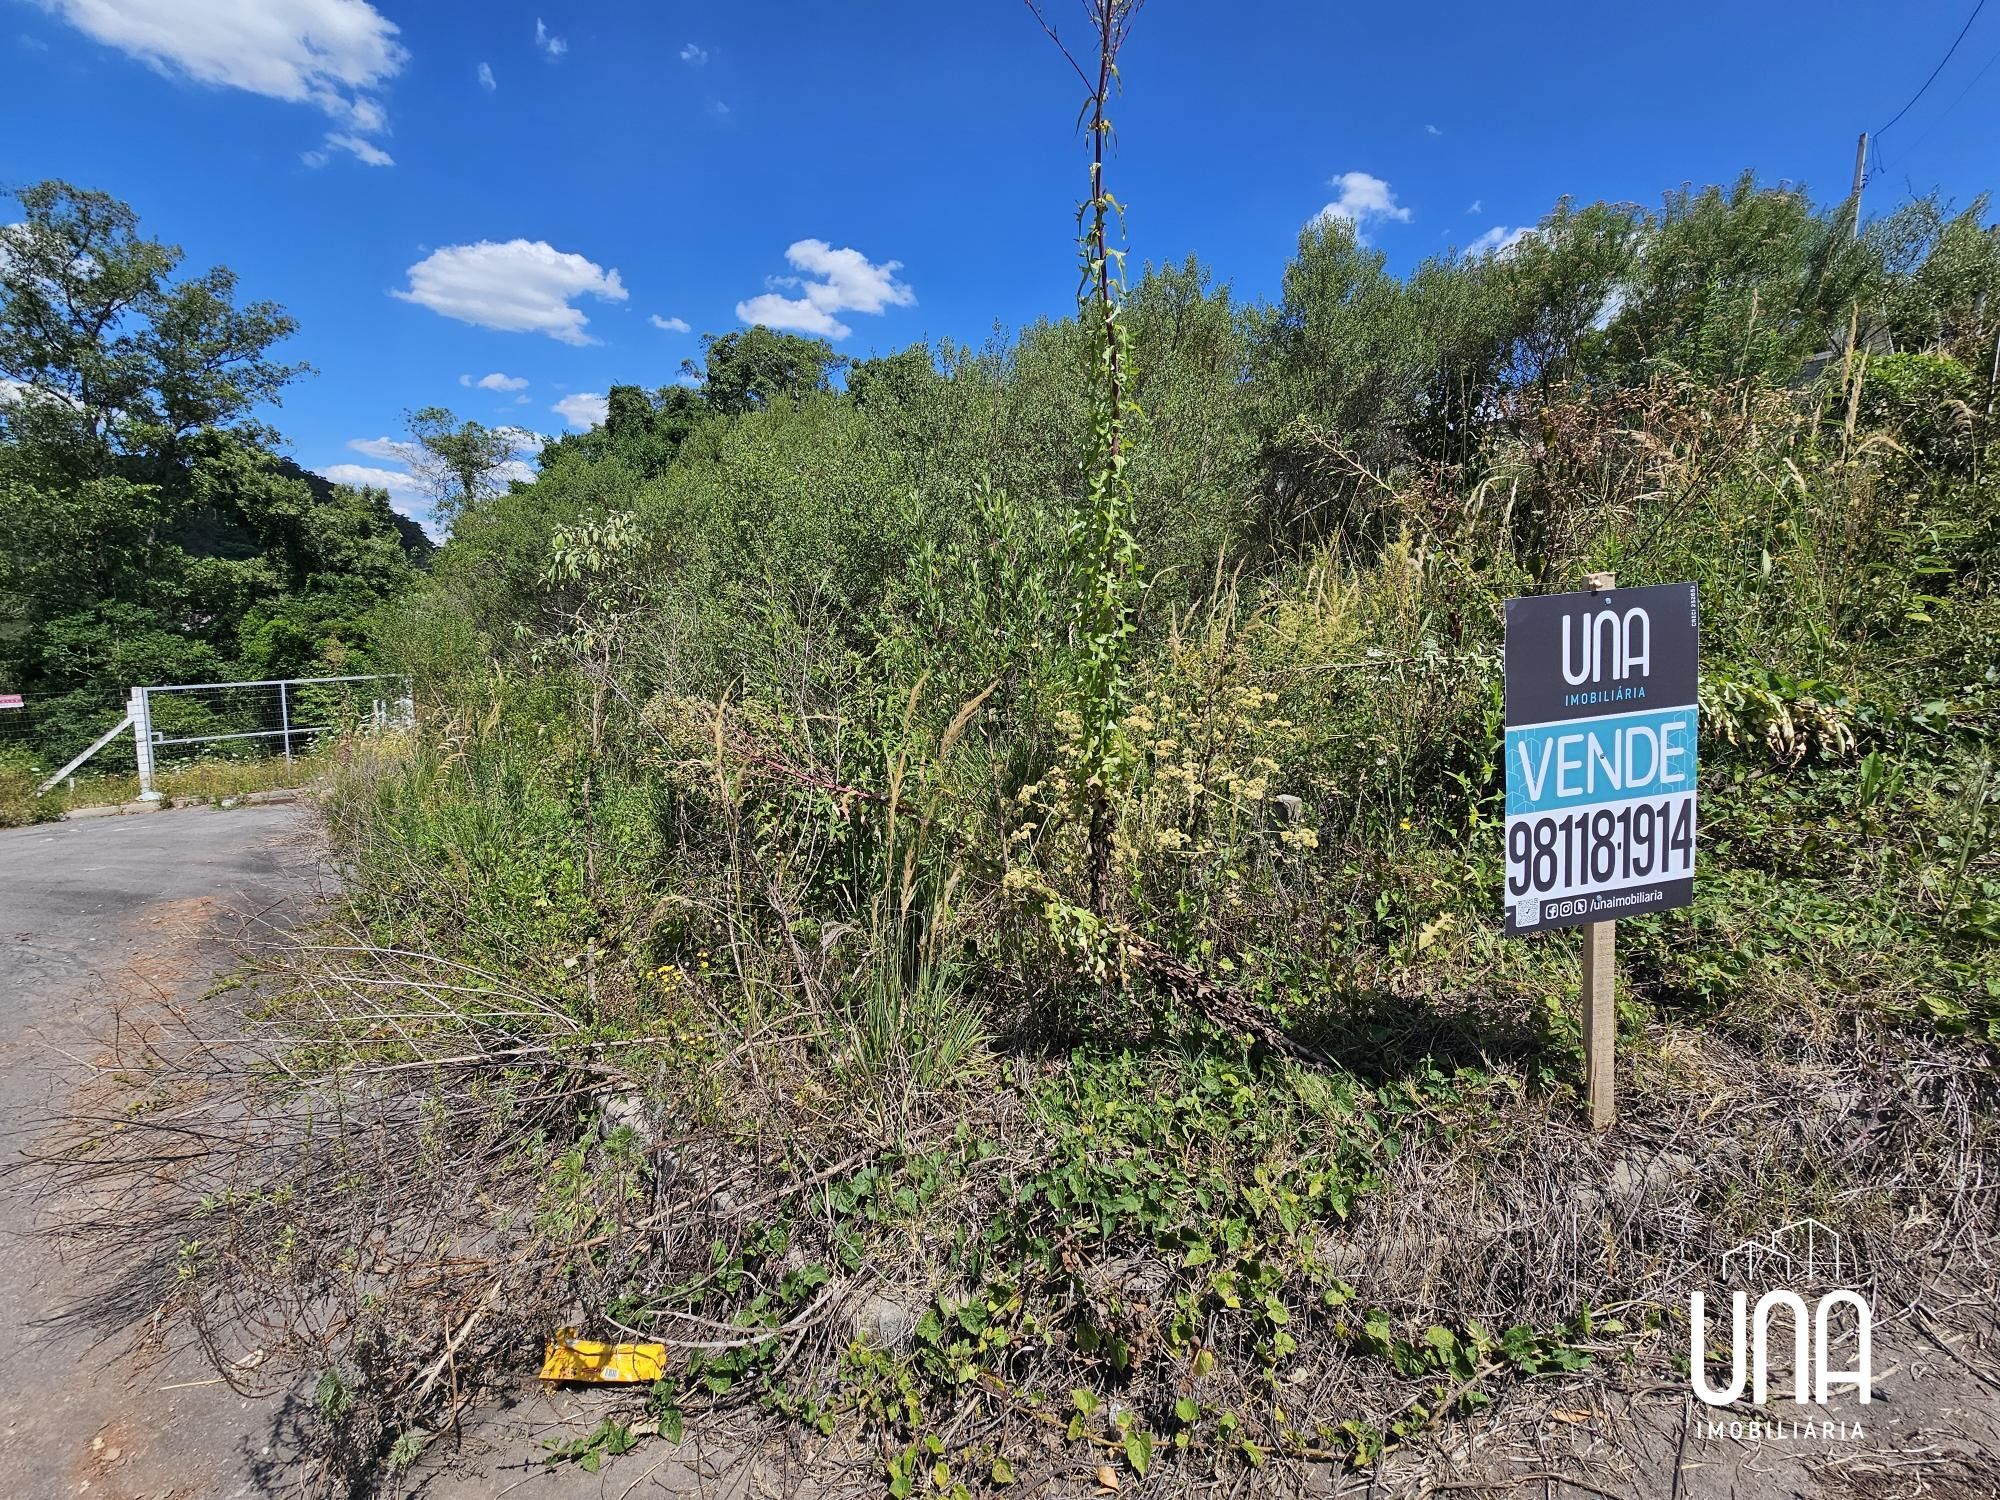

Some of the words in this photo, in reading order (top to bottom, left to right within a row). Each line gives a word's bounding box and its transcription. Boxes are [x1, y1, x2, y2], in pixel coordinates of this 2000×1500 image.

[1562, 607, 1650, 686] UNA
[1565, 686, 1646, 707] IMOBILIÁRIA
[1518, 721, 1687, 801] VENDE
[1590, 890, 1663, 913] /unaimobiliaria
